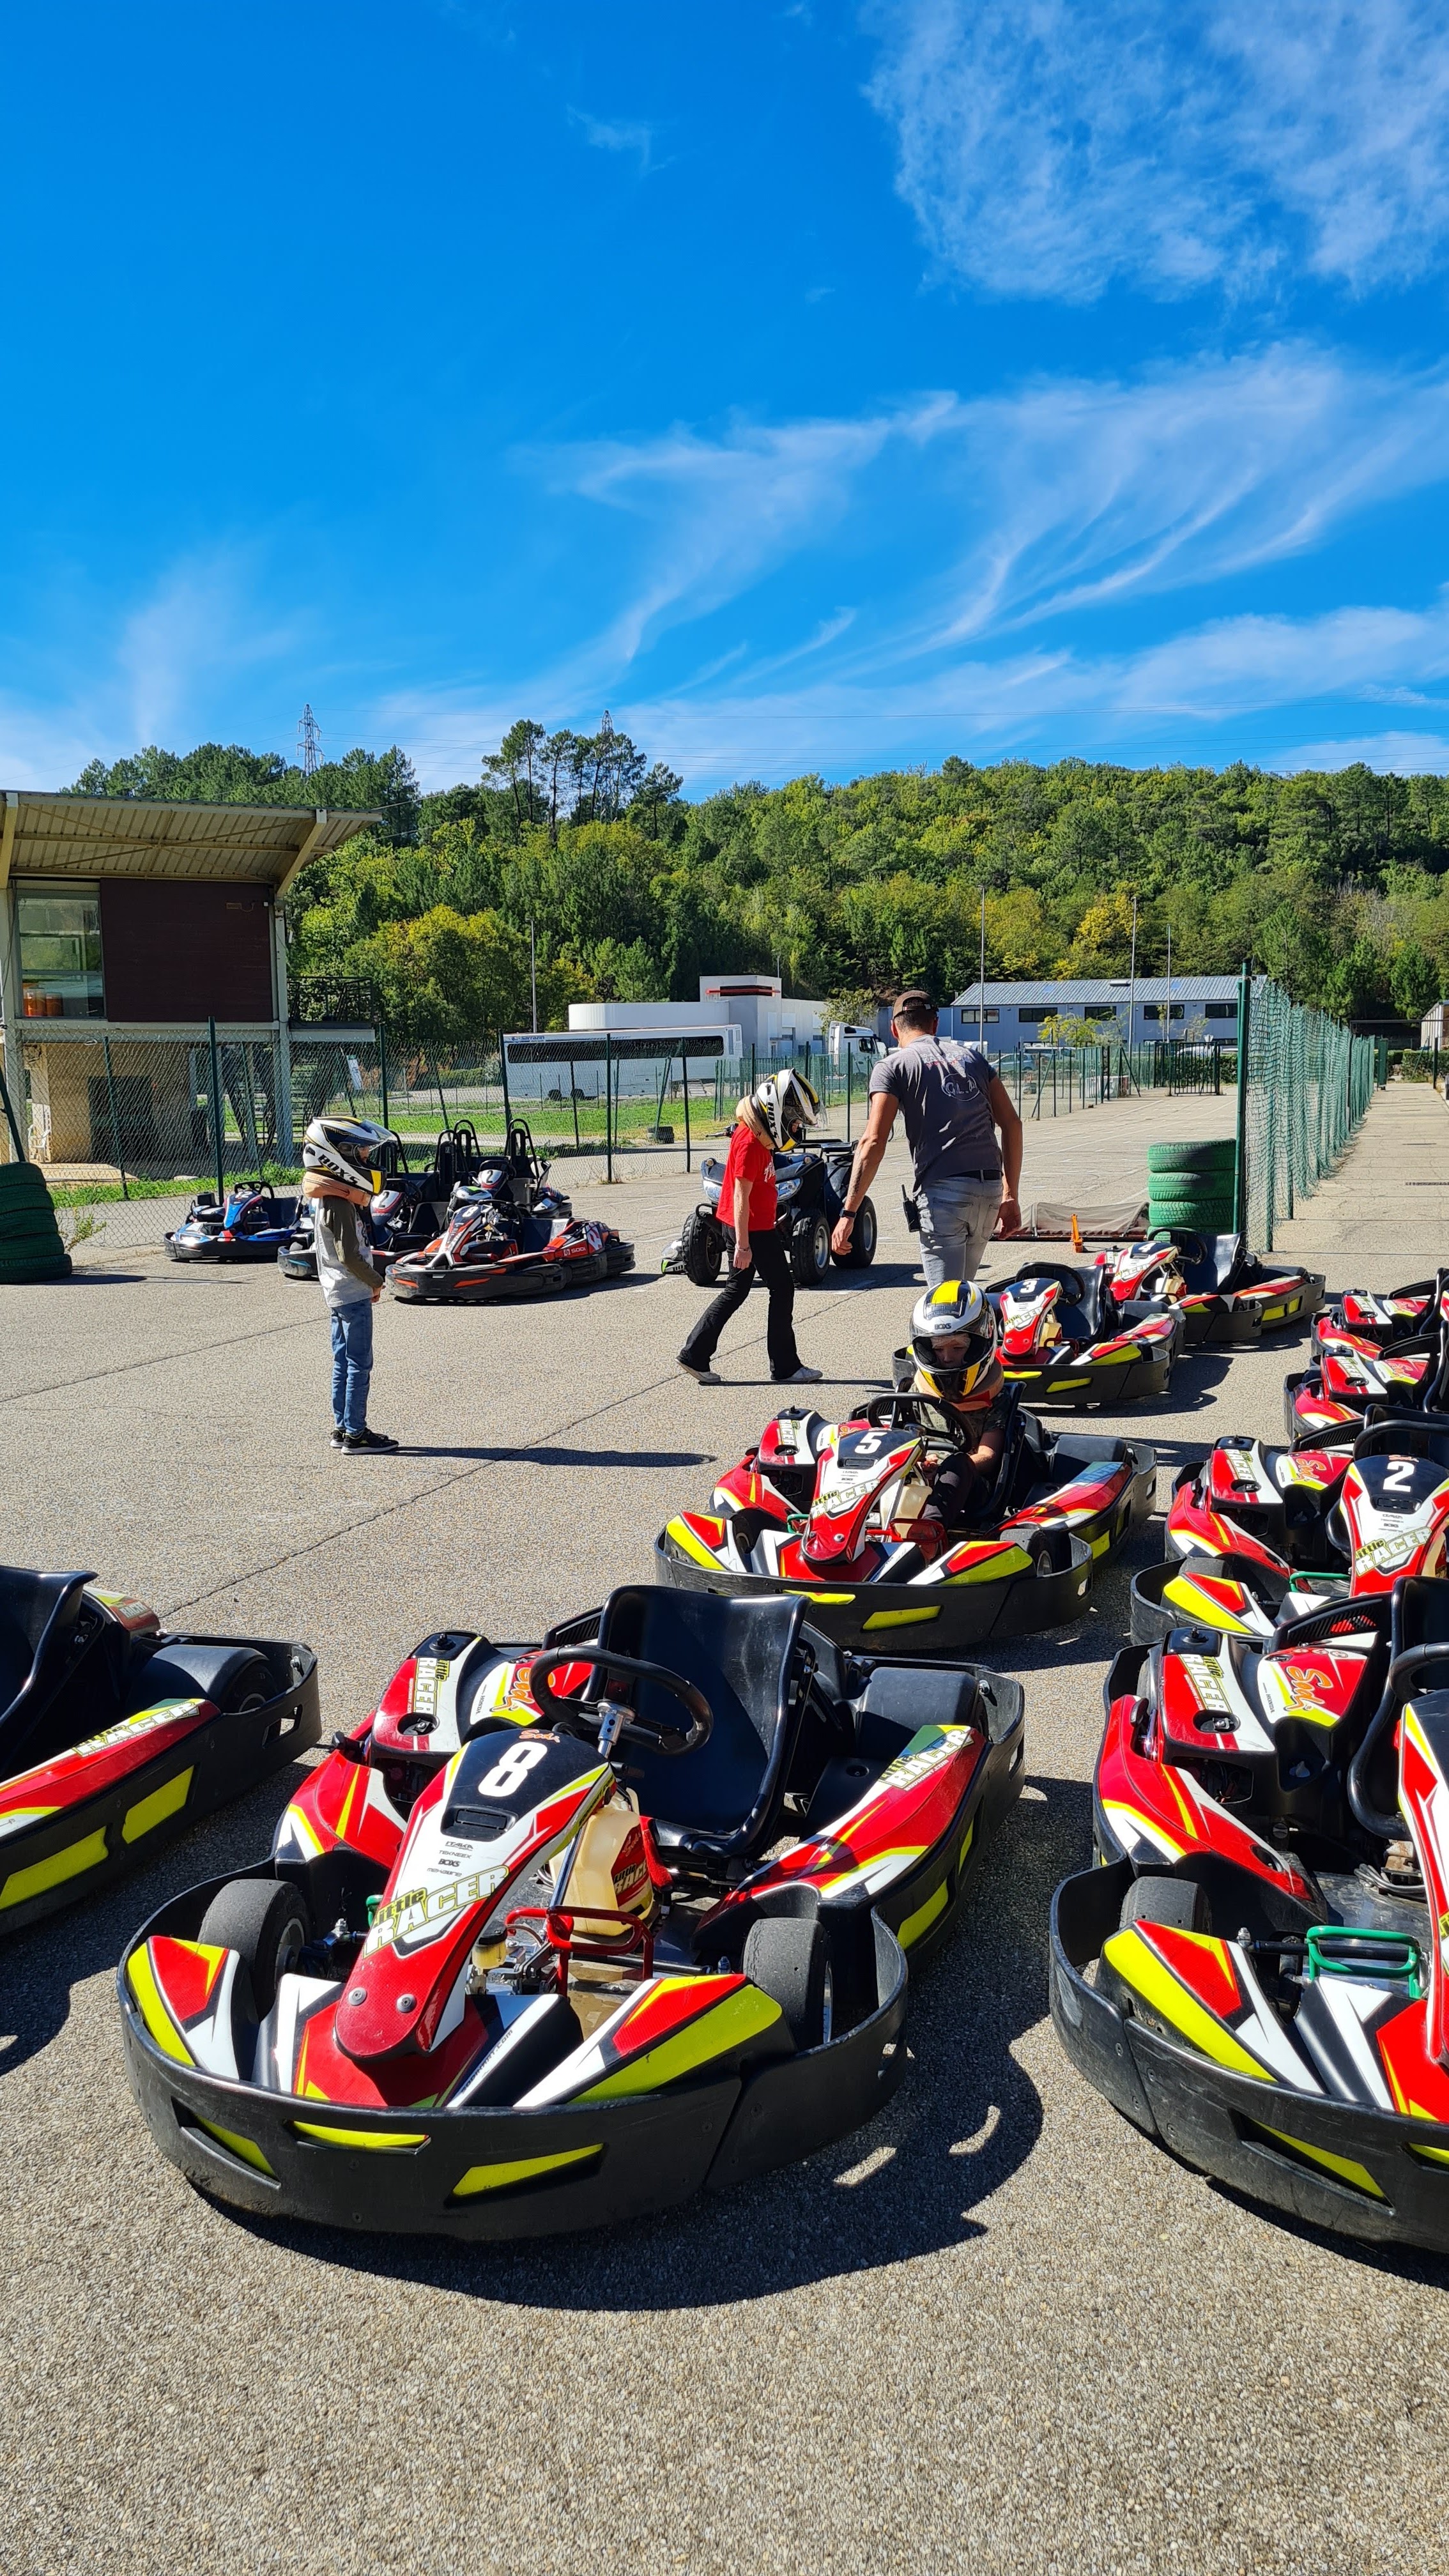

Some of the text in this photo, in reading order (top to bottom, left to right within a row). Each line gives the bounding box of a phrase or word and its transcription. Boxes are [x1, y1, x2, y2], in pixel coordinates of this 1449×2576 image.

[486, 1170, 493, 1183] 2
[378, 1192, 390, 1208] 2
[1138, 1243, 1156, 1252] 4
[1020, 1280, 1038, 1293] 3
[854, 1432, 887, 1454] 5
[1383, 1460, 1414, 1492] 2
[810, 1478, 881, 1519] RACER
[1356, 1526, 1432, 1576] RACER
[437, 1660, 450, 1682] ittle
[1202, 1656, 1223, 1678] ittle
[415, 1658, 437, 1715] RACER
[1178, 1654, 1232, 1713] RACER
[476, 1696, 485, 1714] HONDA
[1266, 1694, 1275, 1713] HONDA
[72, 1702, 199, 1758] RACER
[478, 1741, 548, 1797] 8
[879, 1729, 974, 1788] RACER
[438, 1858, 461, 1867] BOXS
[439, 1850, 471, 1859] TEKNEEX
[364, 1865, 509, 1959] RACER
